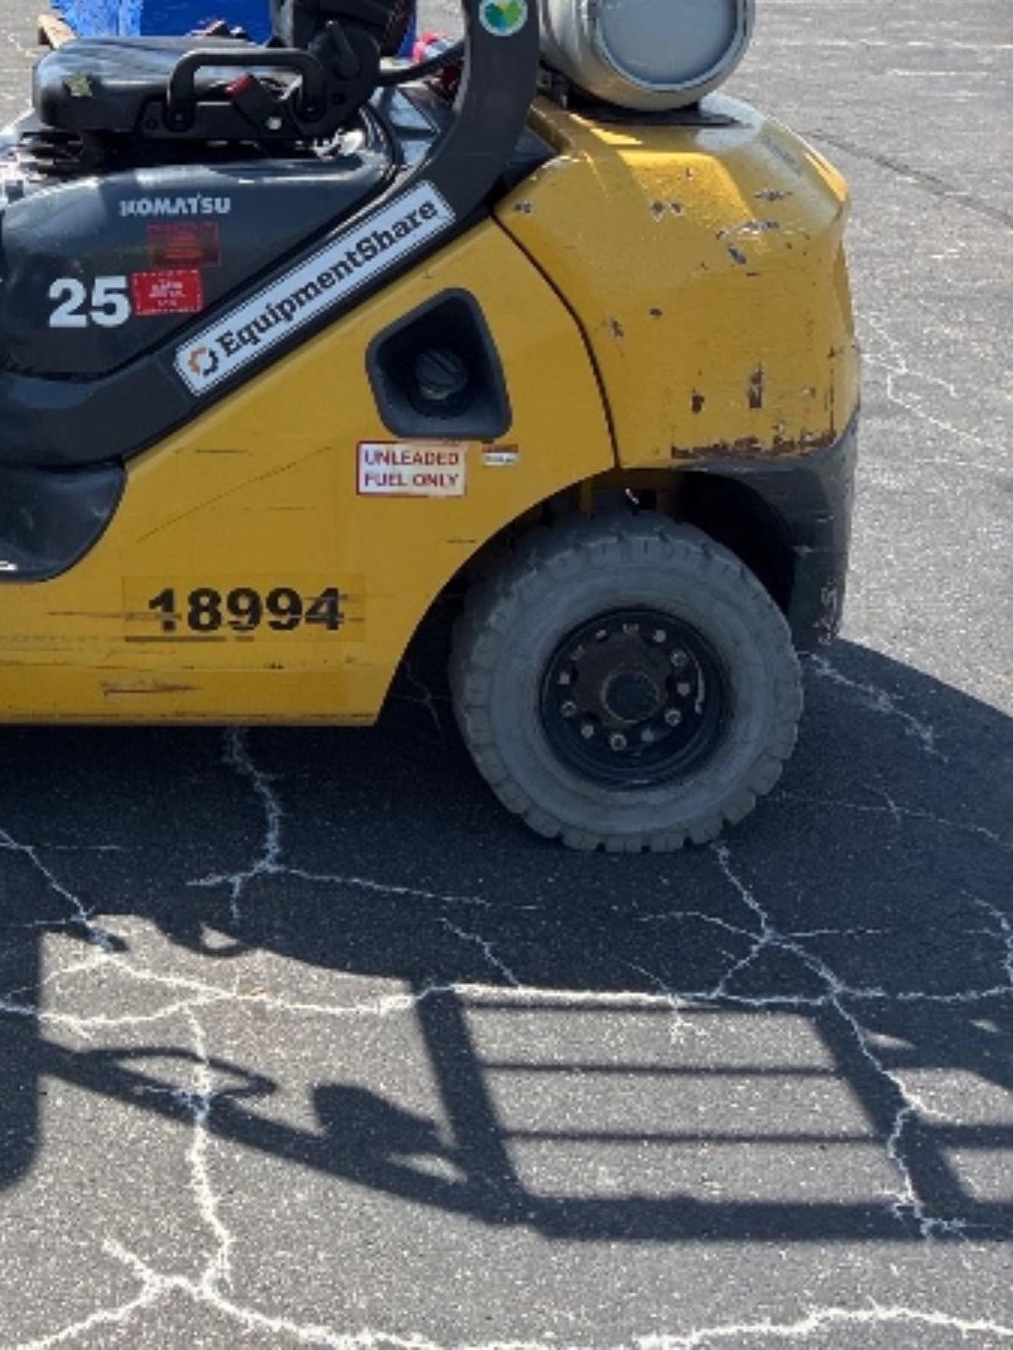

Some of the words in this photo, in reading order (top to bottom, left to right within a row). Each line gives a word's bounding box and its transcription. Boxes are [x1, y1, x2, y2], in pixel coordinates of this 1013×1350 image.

[118, 192, 232, 218] KOMATSU
[215, 200, 438, 357] EquipmentShare
[48, 274, 132, 329] 25
[363, 449, 460, 466] UNLEADED
[363, 472, 407, 488] FUEL
[412, 472, 460, 487] ONLY
[148, 586, 345, 632] 18994
